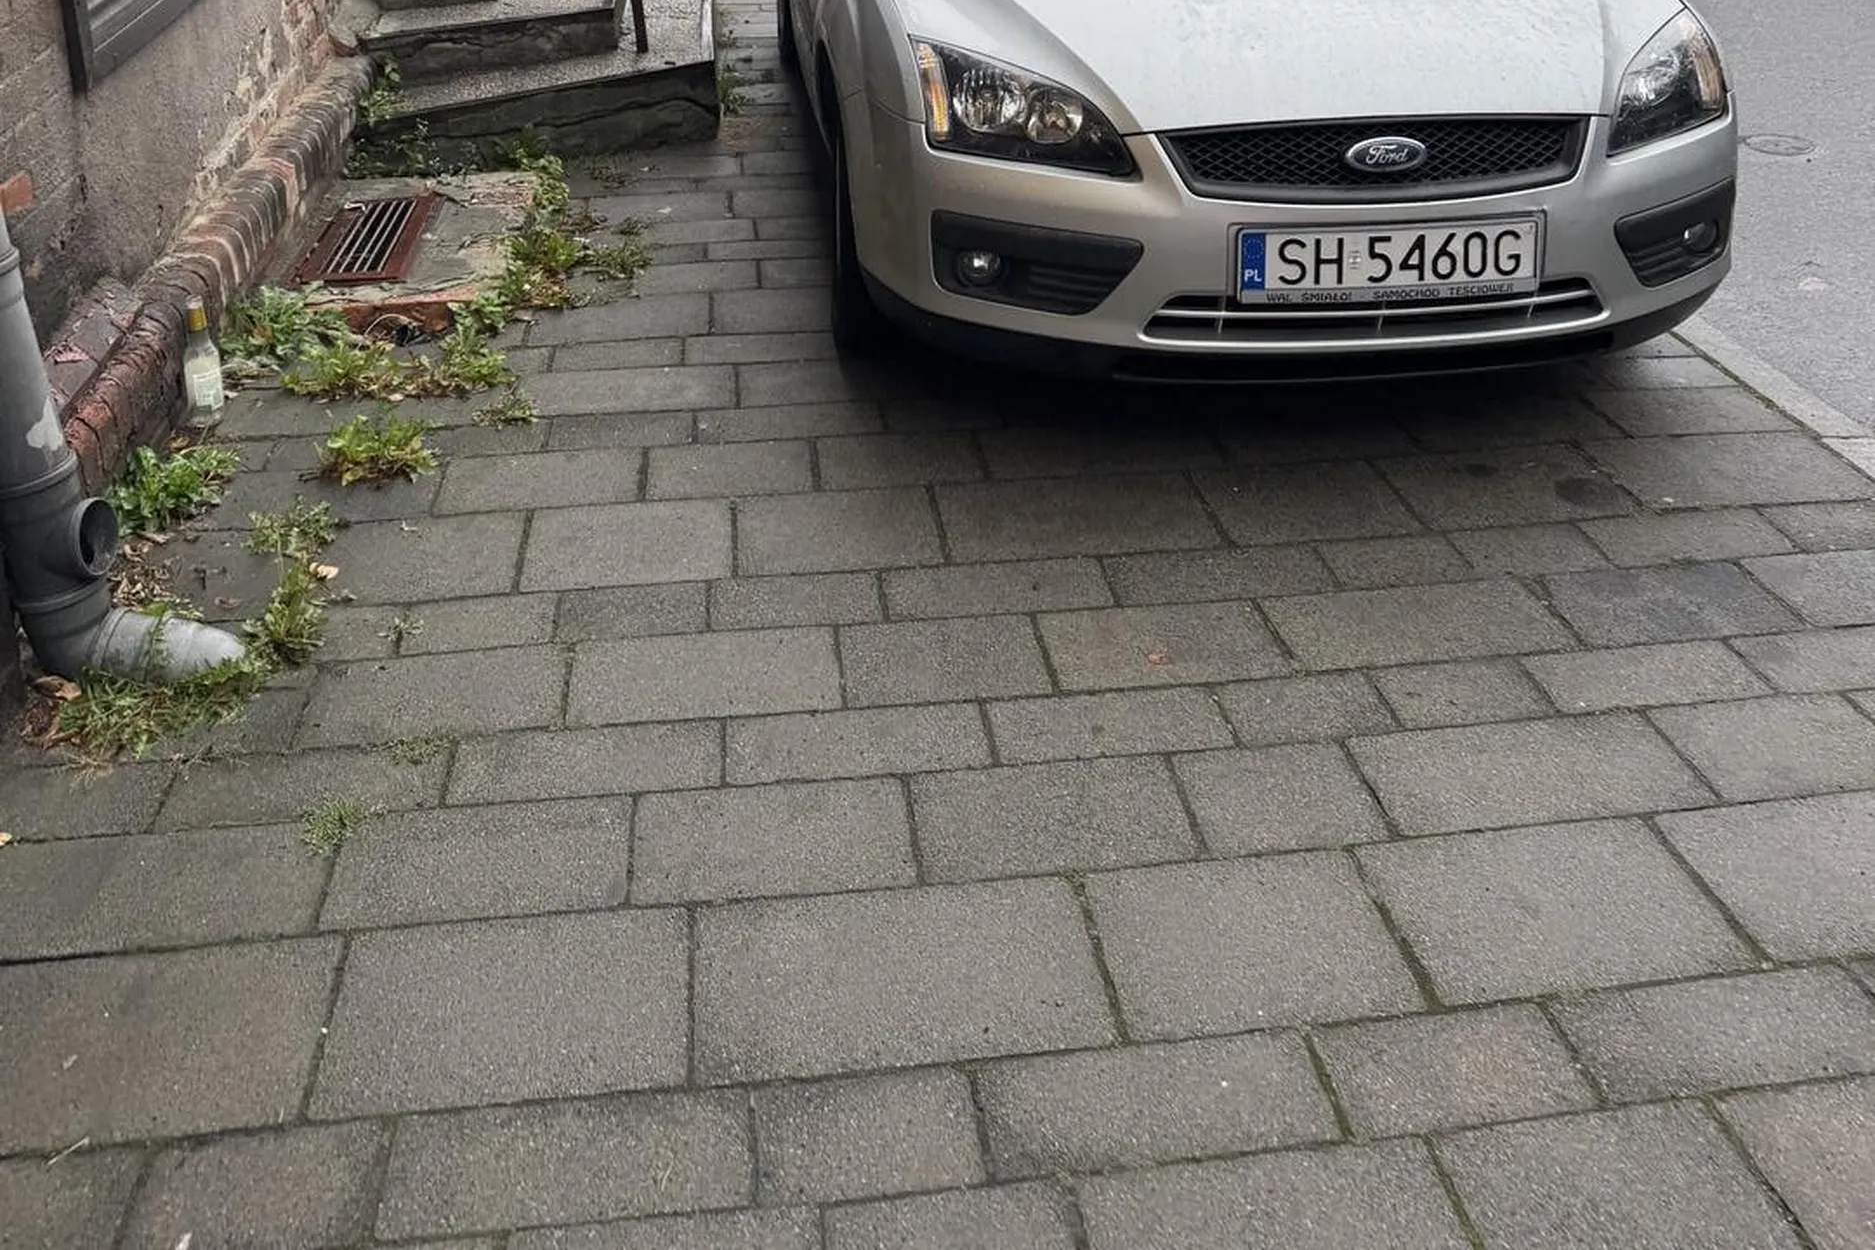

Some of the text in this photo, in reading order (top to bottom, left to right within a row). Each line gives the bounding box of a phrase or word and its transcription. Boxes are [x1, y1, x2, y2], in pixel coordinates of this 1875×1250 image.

[1365, 144, 1409, 165] Ford
[1278, 229, 1522, 286] SH 5460G
[1244, 268, 1263, 282] PL
